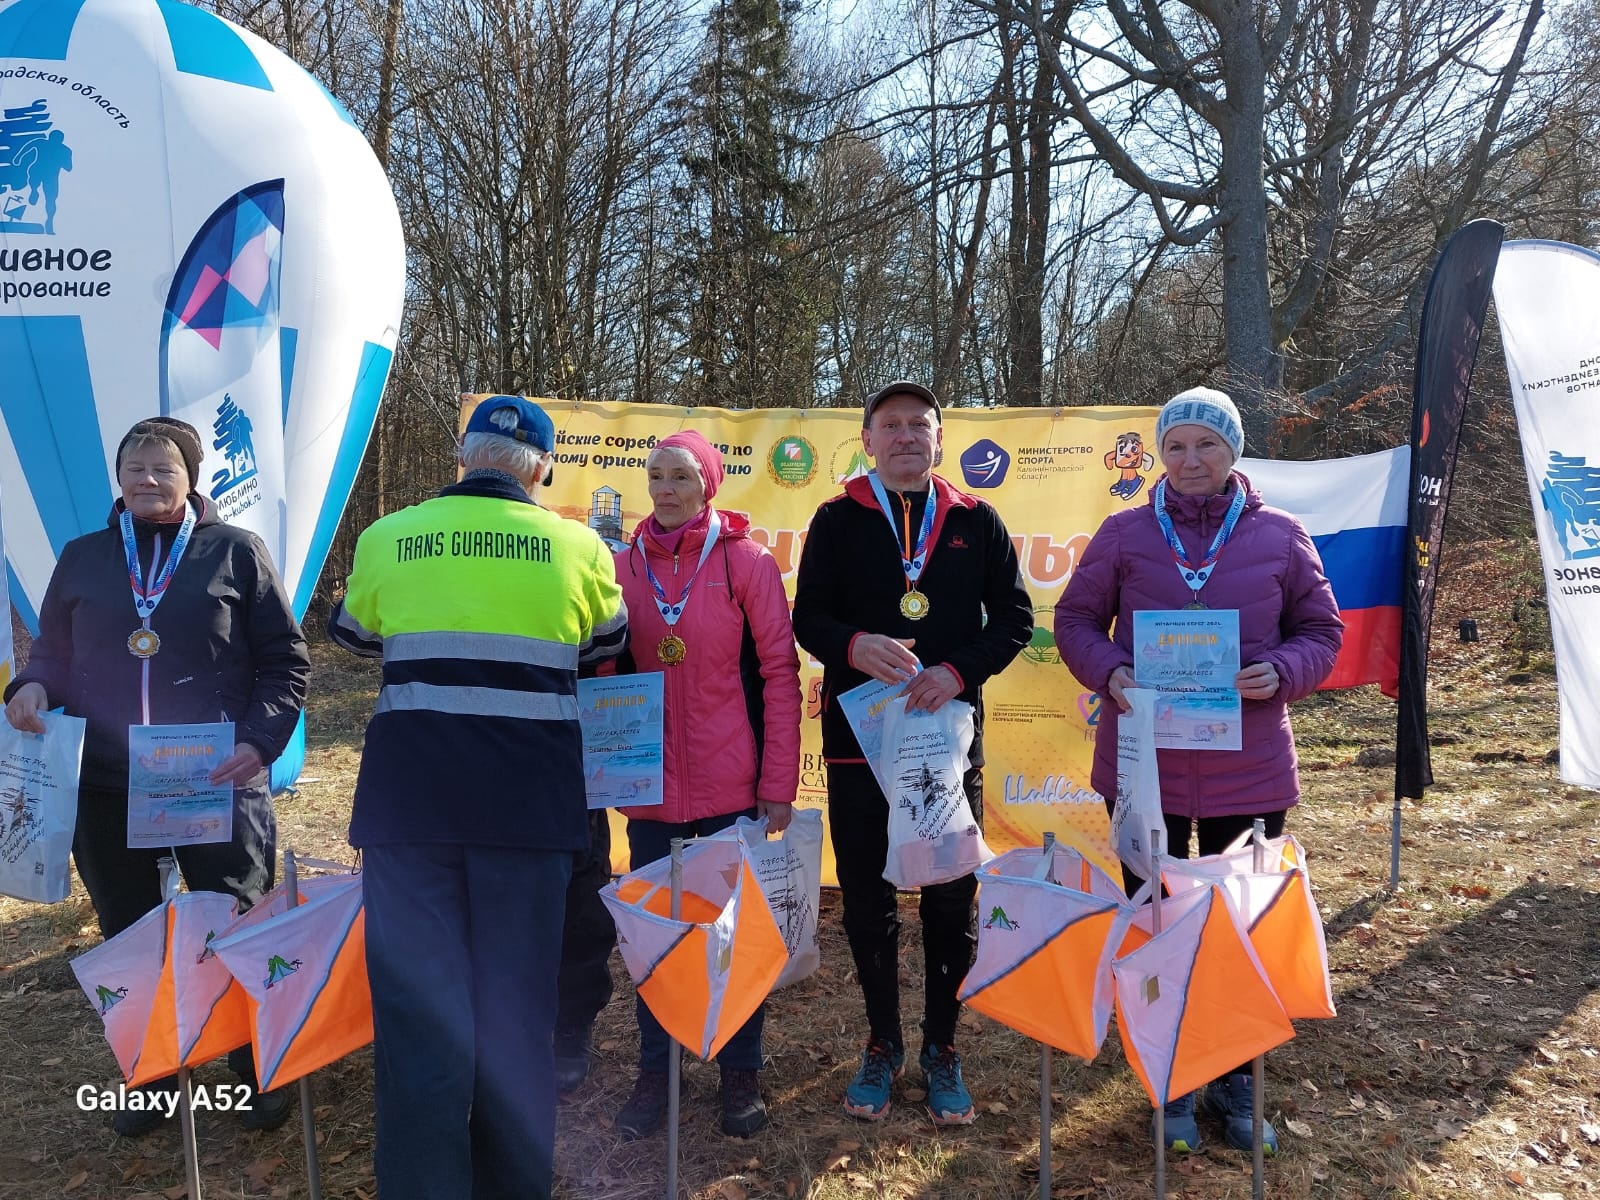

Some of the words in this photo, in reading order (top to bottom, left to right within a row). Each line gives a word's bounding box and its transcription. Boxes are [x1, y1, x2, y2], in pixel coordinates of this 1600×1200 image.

[71, 82, 130, 129] область
[0, 281, 111, 304] рование
[732, 445, 753, 456] по
[1017, 456, 1054, 465] СПОРТА
[1018, 446, 1094, 455] МИНИСТЕРСТВО
[218, 477, 258, 511] ЛЮБЛИНО
[396, 531, 445, 564] TRANS
[451, 531, 552, 564] GUARDAMAR
